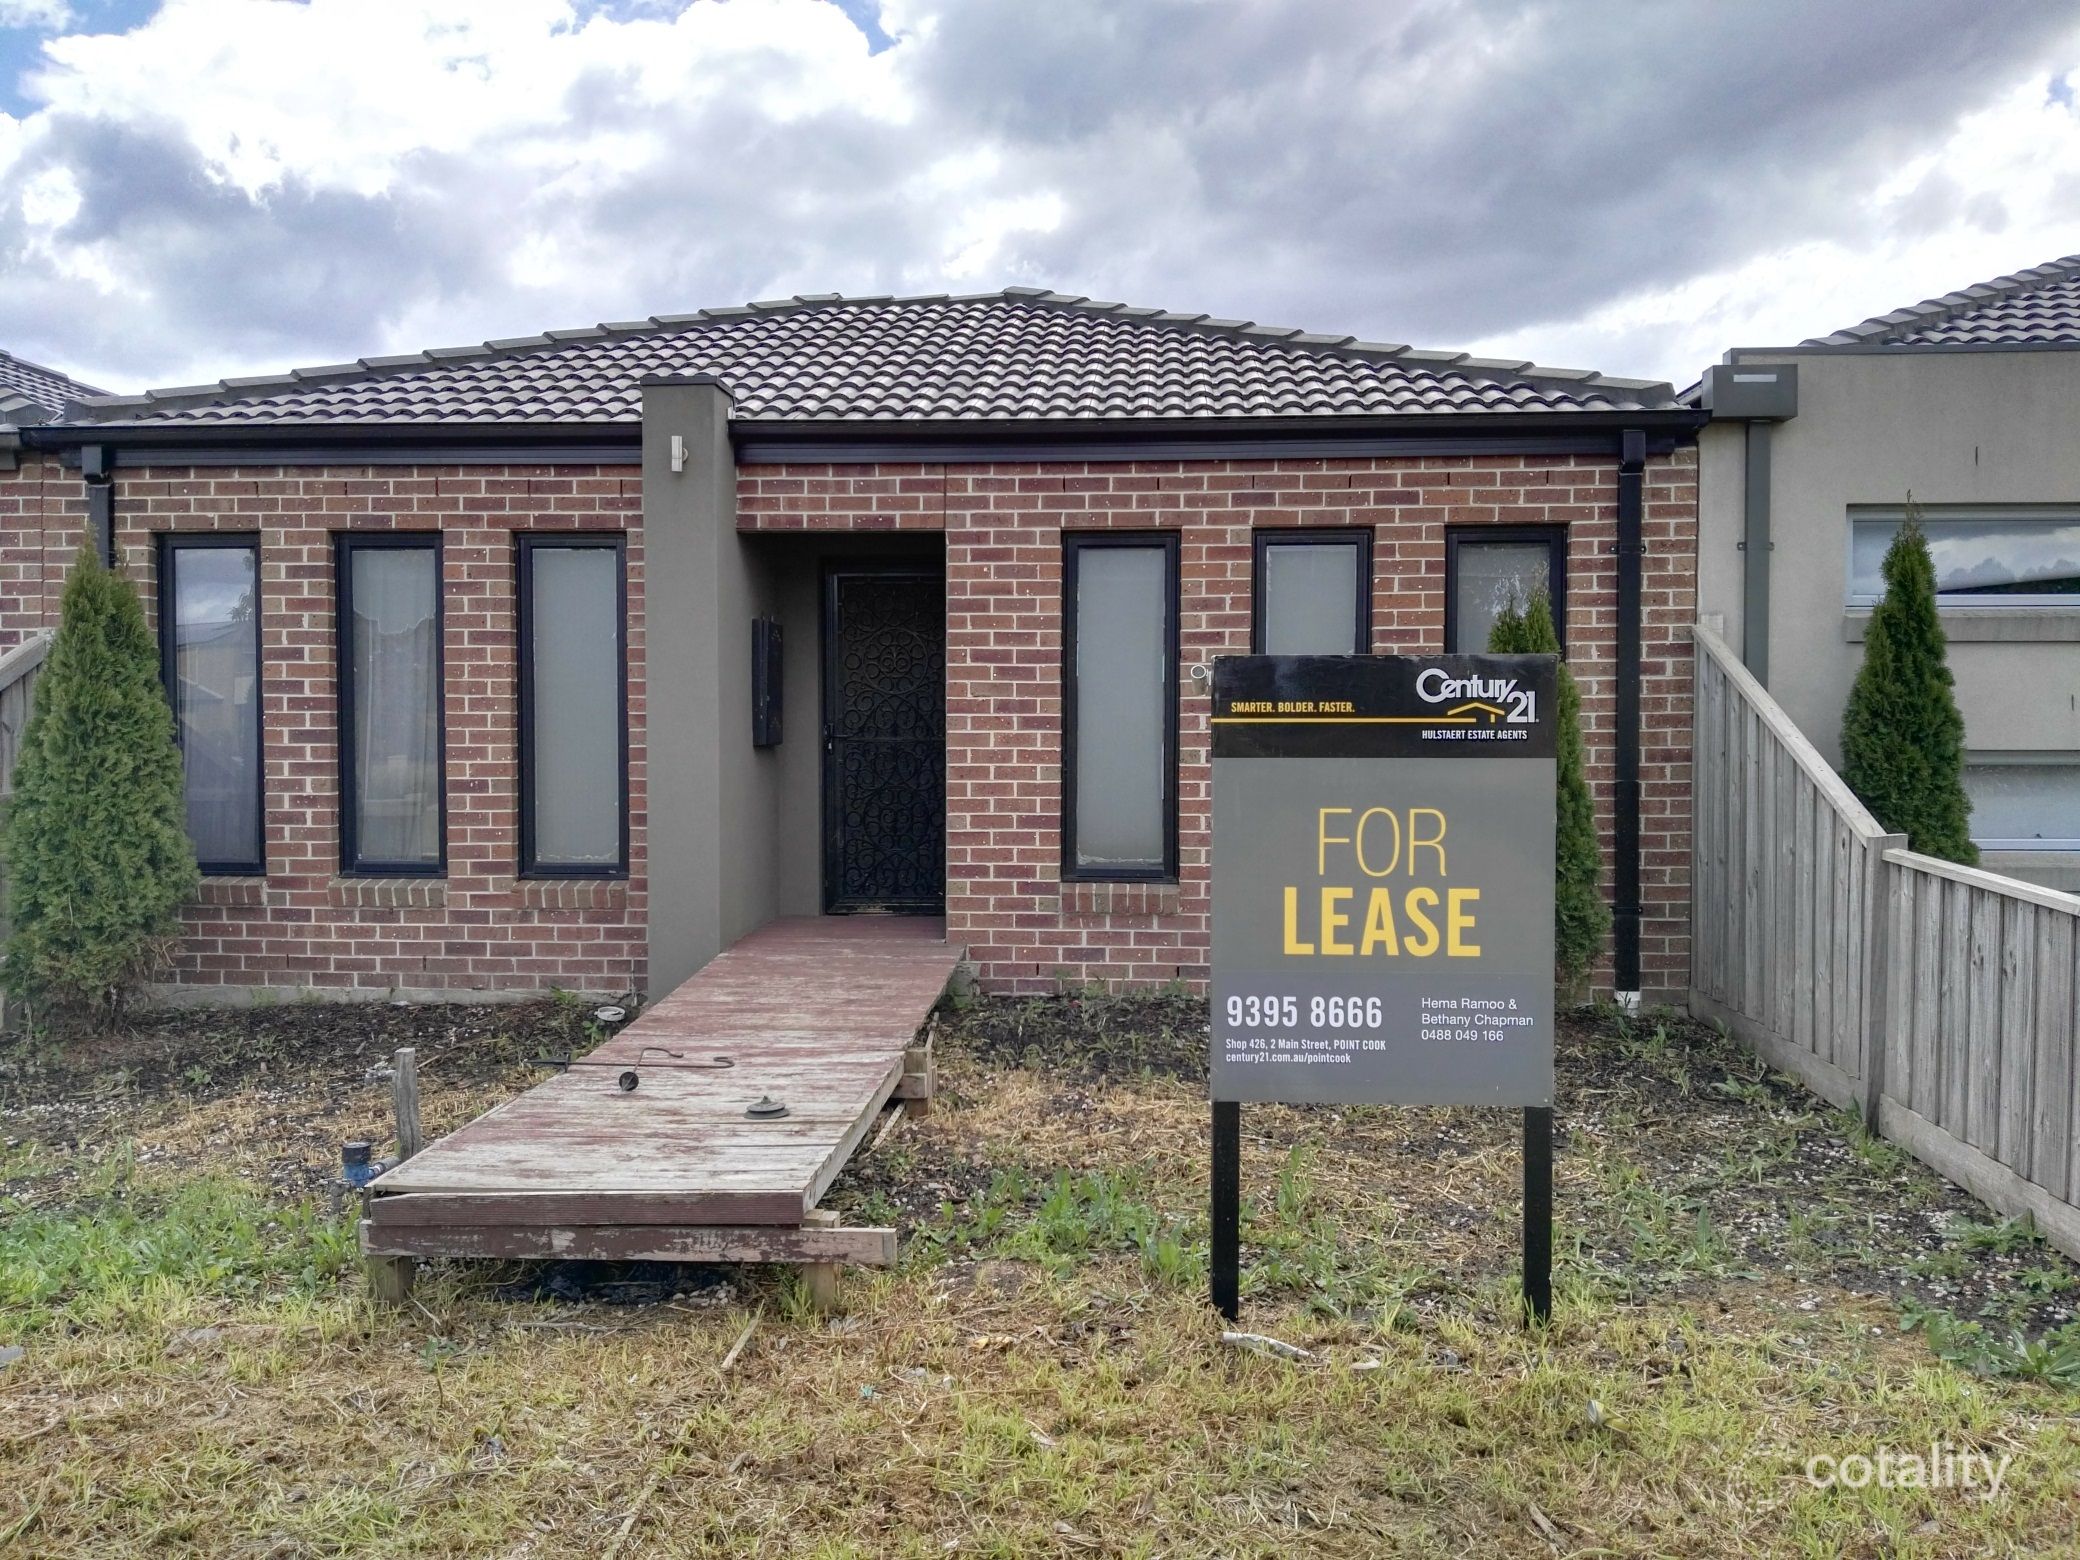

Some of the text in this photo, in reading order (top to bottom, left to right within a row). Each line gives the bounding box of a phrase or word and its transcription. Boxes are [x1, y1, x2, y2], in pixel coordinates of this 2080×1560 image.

[1416, 668, 1517, 703] Century
[1231, 702, 1355, 713] SMARTER. BOLDER. FASTER.
[1422, 730, 1528, 740] HULSTAERT ESTATE AGENTS
[1318, 807, 1447, 877] FOR
[1283, 886, 1481, 957] LEASE
[1421, 997, 1517, 1010] Hema Ramoo &
[1226, 995, 1383, 1028] 9395 8666
[1421, 1013, 1534, 1027] Bethany Chapman
[1421, 1029, 1504, 1041] 0488 049 166
[1225, 1038, 1386, 1051] Shop 426, 2 Main Street, POINT COOK
[1225, 1052, 1351, 1064] century21.com.au/pointcook
